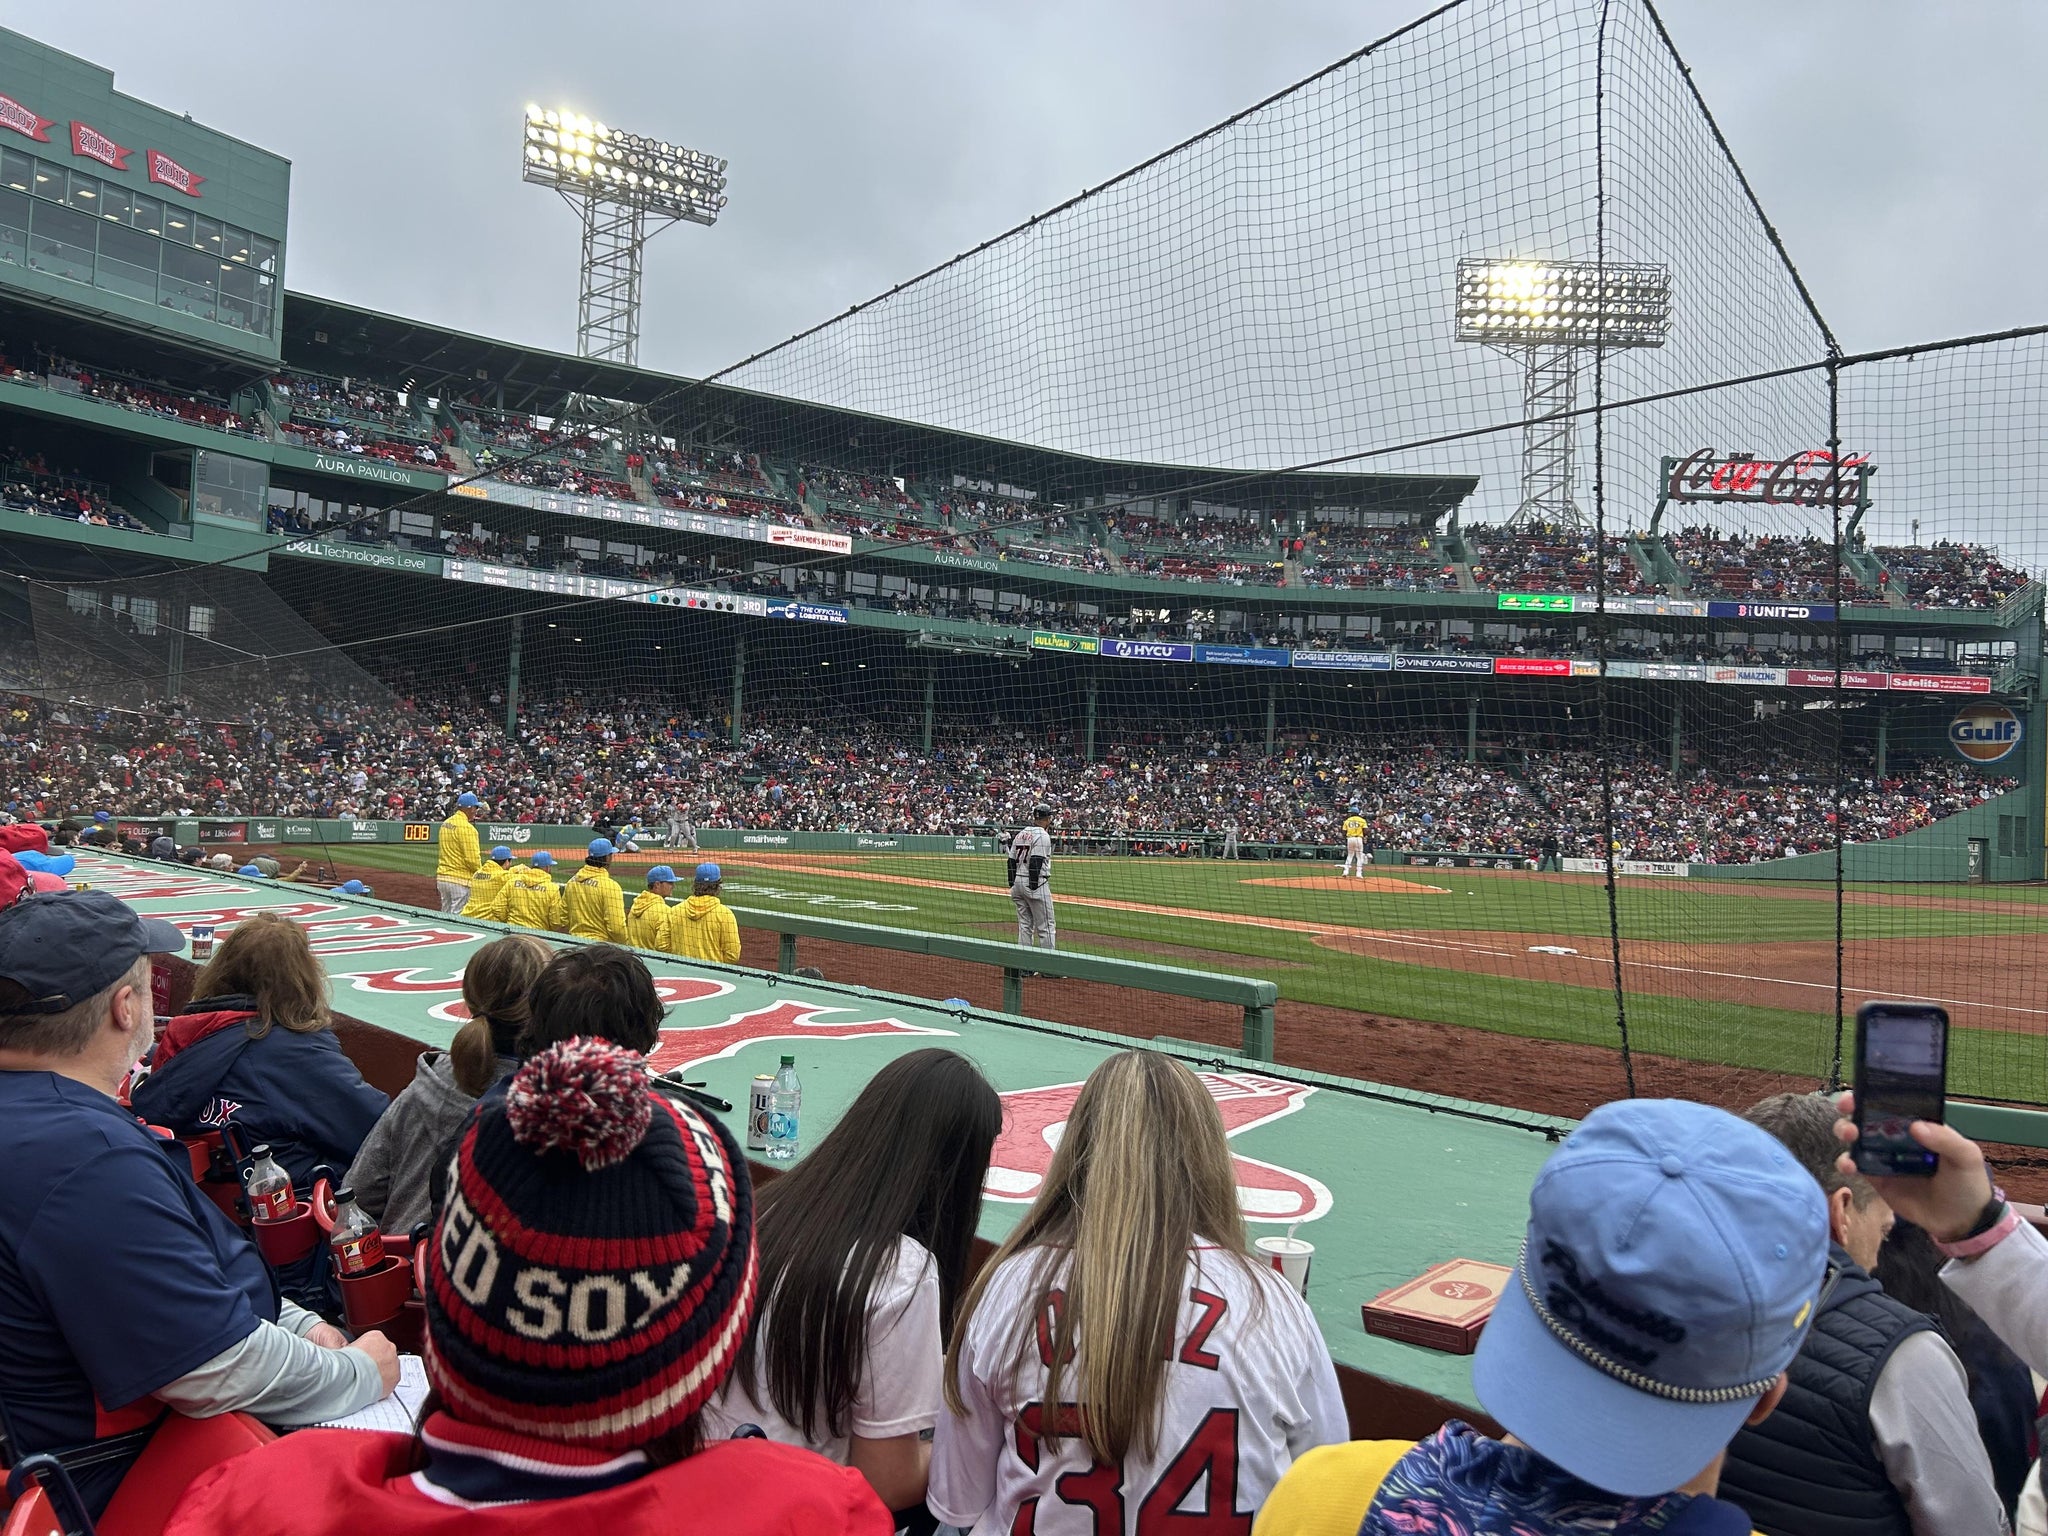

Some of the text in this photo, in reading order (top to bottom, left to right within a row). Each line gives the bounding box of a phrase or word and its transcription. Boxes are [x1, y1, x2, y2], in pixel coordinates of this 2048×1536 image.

[0, 101, 38, 131] 2007
[79, 131, 116, 160] 2013
[155, 159, 189, 187] 2018
[358, 465, 411, 485] PAVILION
[286, 540, 426, 570] DELL Technologies Level
[962, 558, 999, 572] PAVILION
[483, 567, 509, 576] DETROIT
[484, 576, 508, 585] BOSTON
[686, 591, 711, 600] STRIKE
[717, 594, 732, 603] OUT
[743, 600, 761, 612] 3RD
[799, 606, 814, 614] THE
[813, 607, 843, 617] OFFICIAL
[1753, 605, 1811, 619] UNITED
[799, 612, 847, 624] LOBSTER ROLL
[1034, 633, 1097, 652] SULLIVAN TIRE
[1134, 645, 1174, 658] HYCU
[1294, 653, 1391, 664] COGHLIN COMPANIES
[1406, 658, 1491, 670] VINEYARD VINES
[1738, 672, 1777, 682] AMAZING
[1807, 674, 1868, 684] Ninety Nine
[1892, 677, 1939, 688] Safelite
[1950, 720, 2017, 742] Gulf
[404, 824, 430, 841] 008
[489, 825, 515, 835] Ninety
[489, 832, 513, 842] Nine
[743, 834, 790, 846] smartwater
[873, 840, 899, 849] TICKET
[1015, 845, 1031, 864] 77
[1652, 863, 1676, 873] TRULY
[1011, 1400, 1256, 1536] 34
